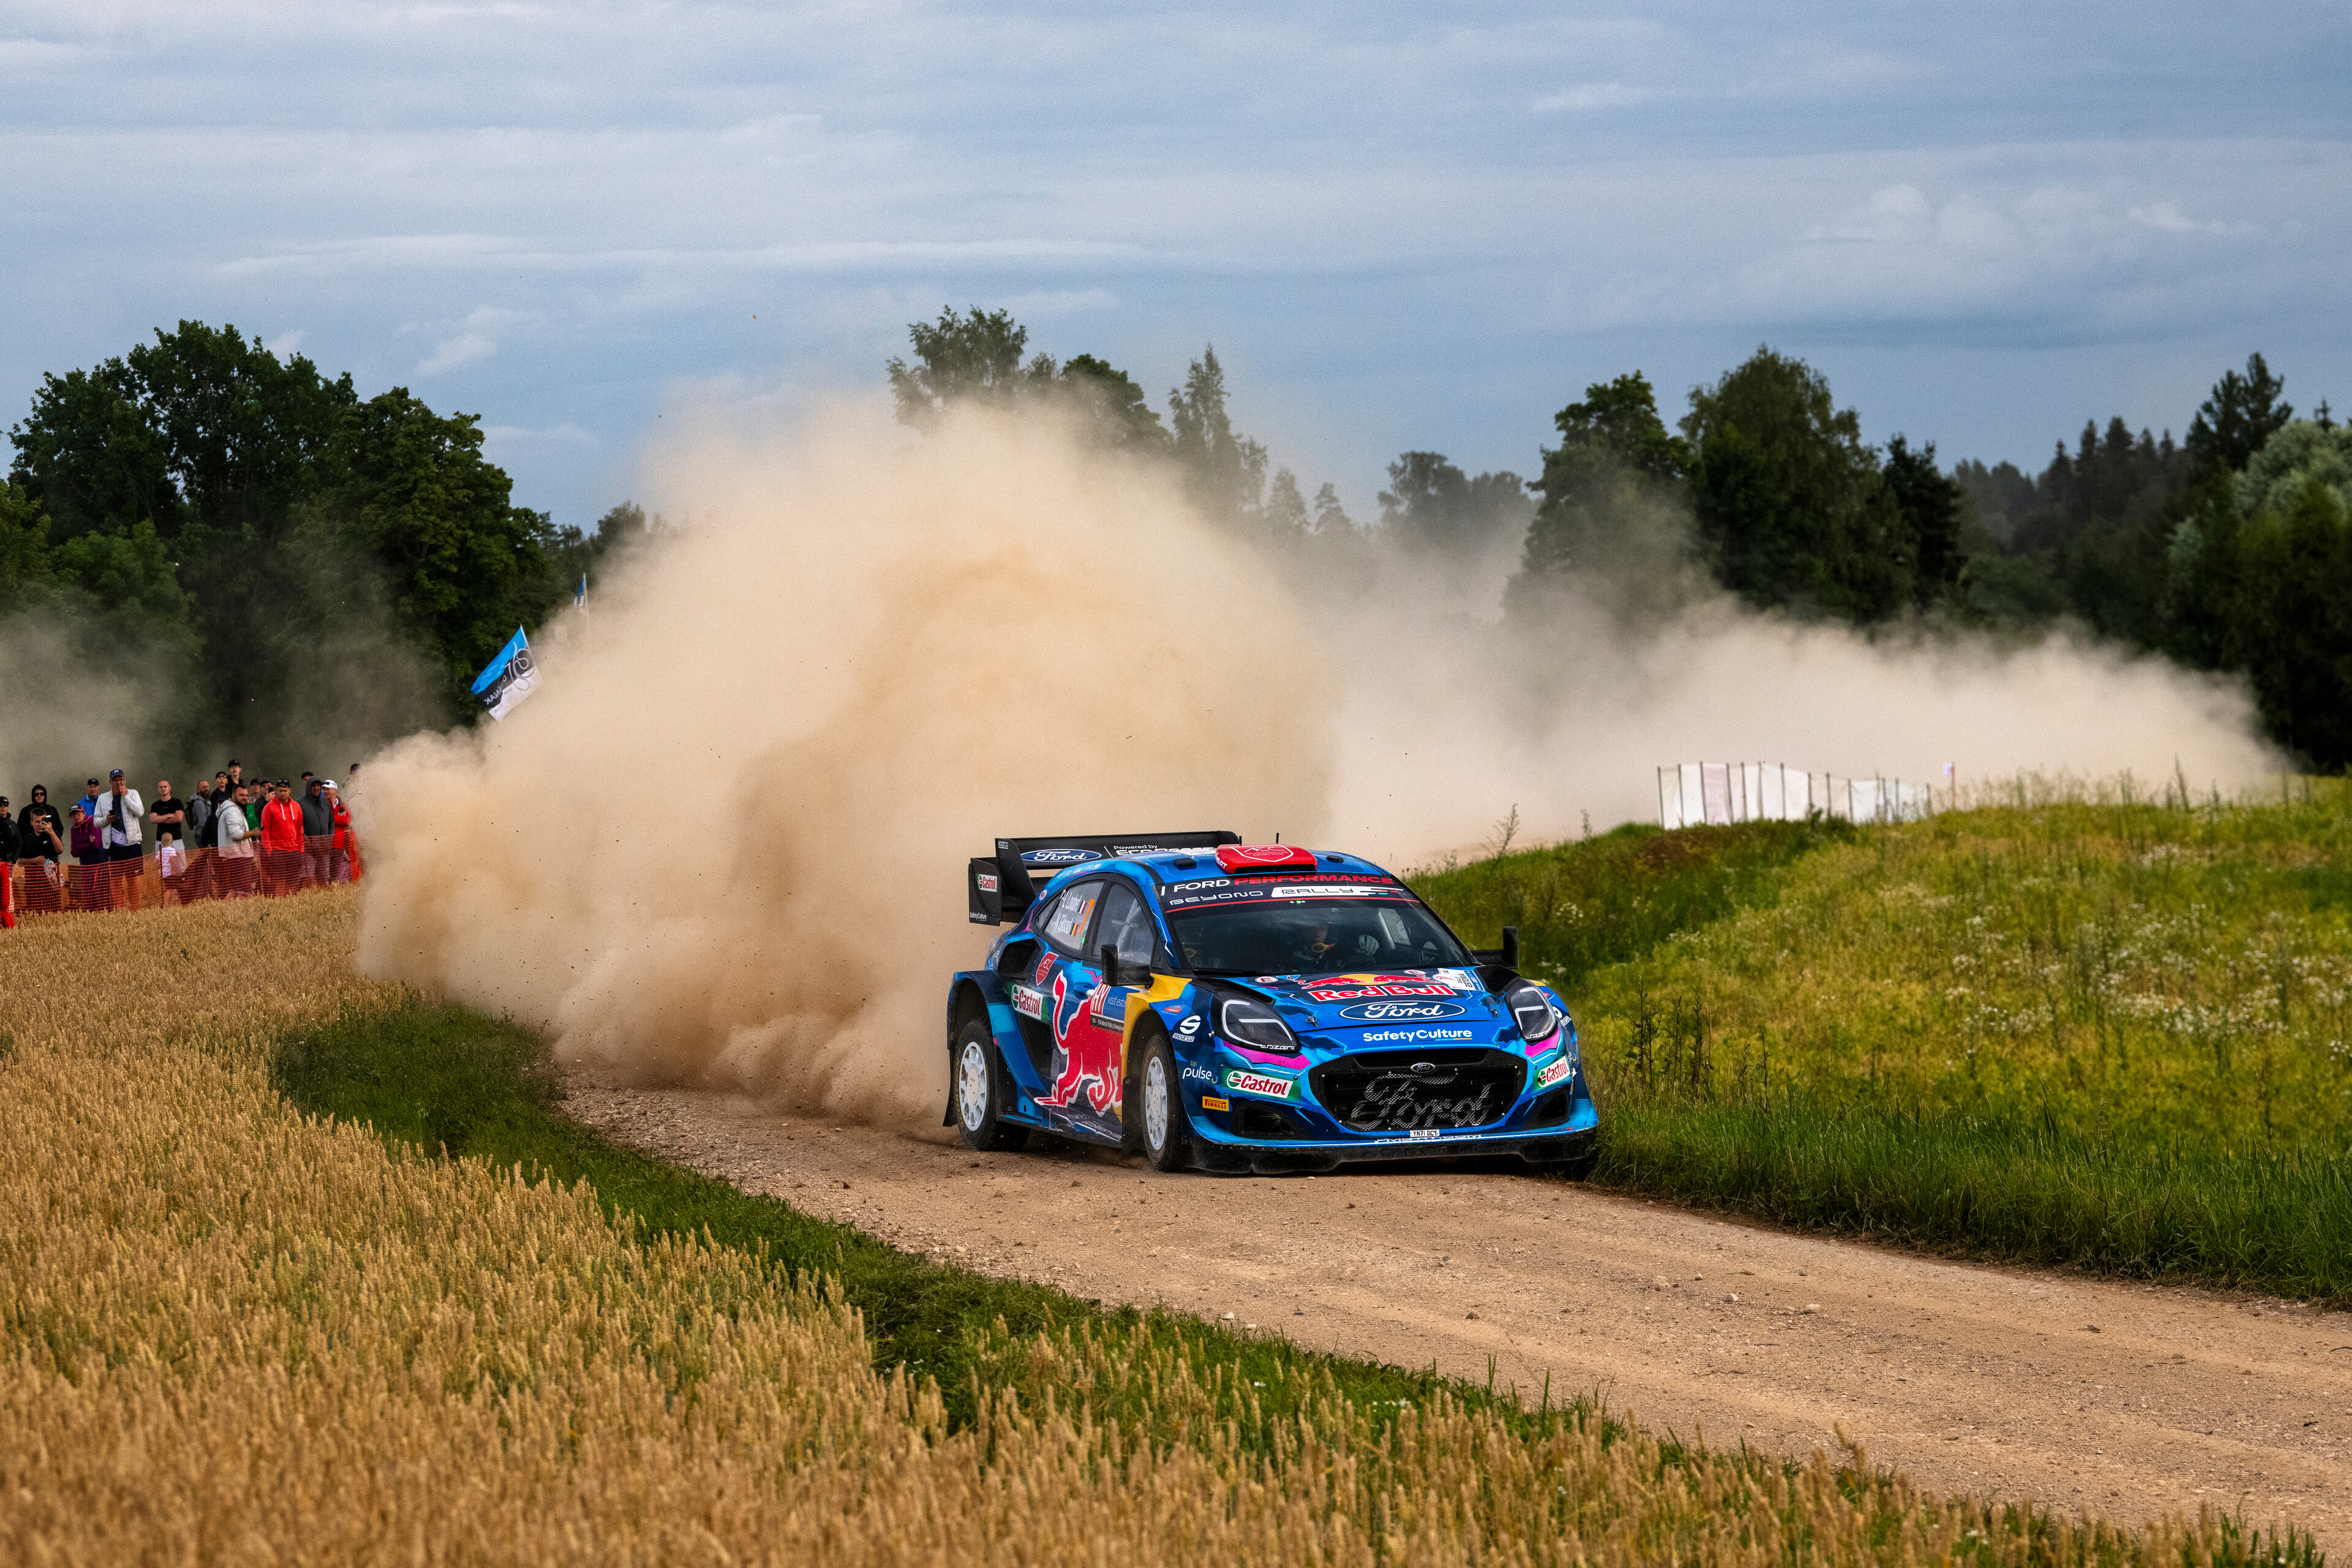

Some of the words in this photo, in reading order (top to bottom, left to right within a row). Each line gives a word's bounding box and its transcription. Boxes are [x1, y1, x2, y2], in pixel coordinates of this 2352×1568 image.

[1034, 851, 1087, 861] Ford
[982, 876, 996, 890] Castrol
[1174, 880, 1231, 892] FORD
[1234, 875, 1394, 885] PERFORMANCE
[1170, 891, 1264, 905] BEYOND
[970, 911, 987, 921] SafetyCulture
[1309, 986, 1387, 1001] Red
[1382, 985, 1457, 997] Bull
[1019, 990, 1041, 1016] Castrol
[1117, 998, 1126, 1008] esto
[1364, 1002, 1444, 1019] Ford
[1363, 1029, 1472, 1042] SafetyCulture
[1182, 1066, 1212, 1080] pulse
[1547, 1058, 1569, 1083] Castrol
[1240, 1075, 1288, 1096] Castrol
[1205, 1098, 1226, 1109] PIRELLI
[1347, 1071, 1494, 1131] Ford
